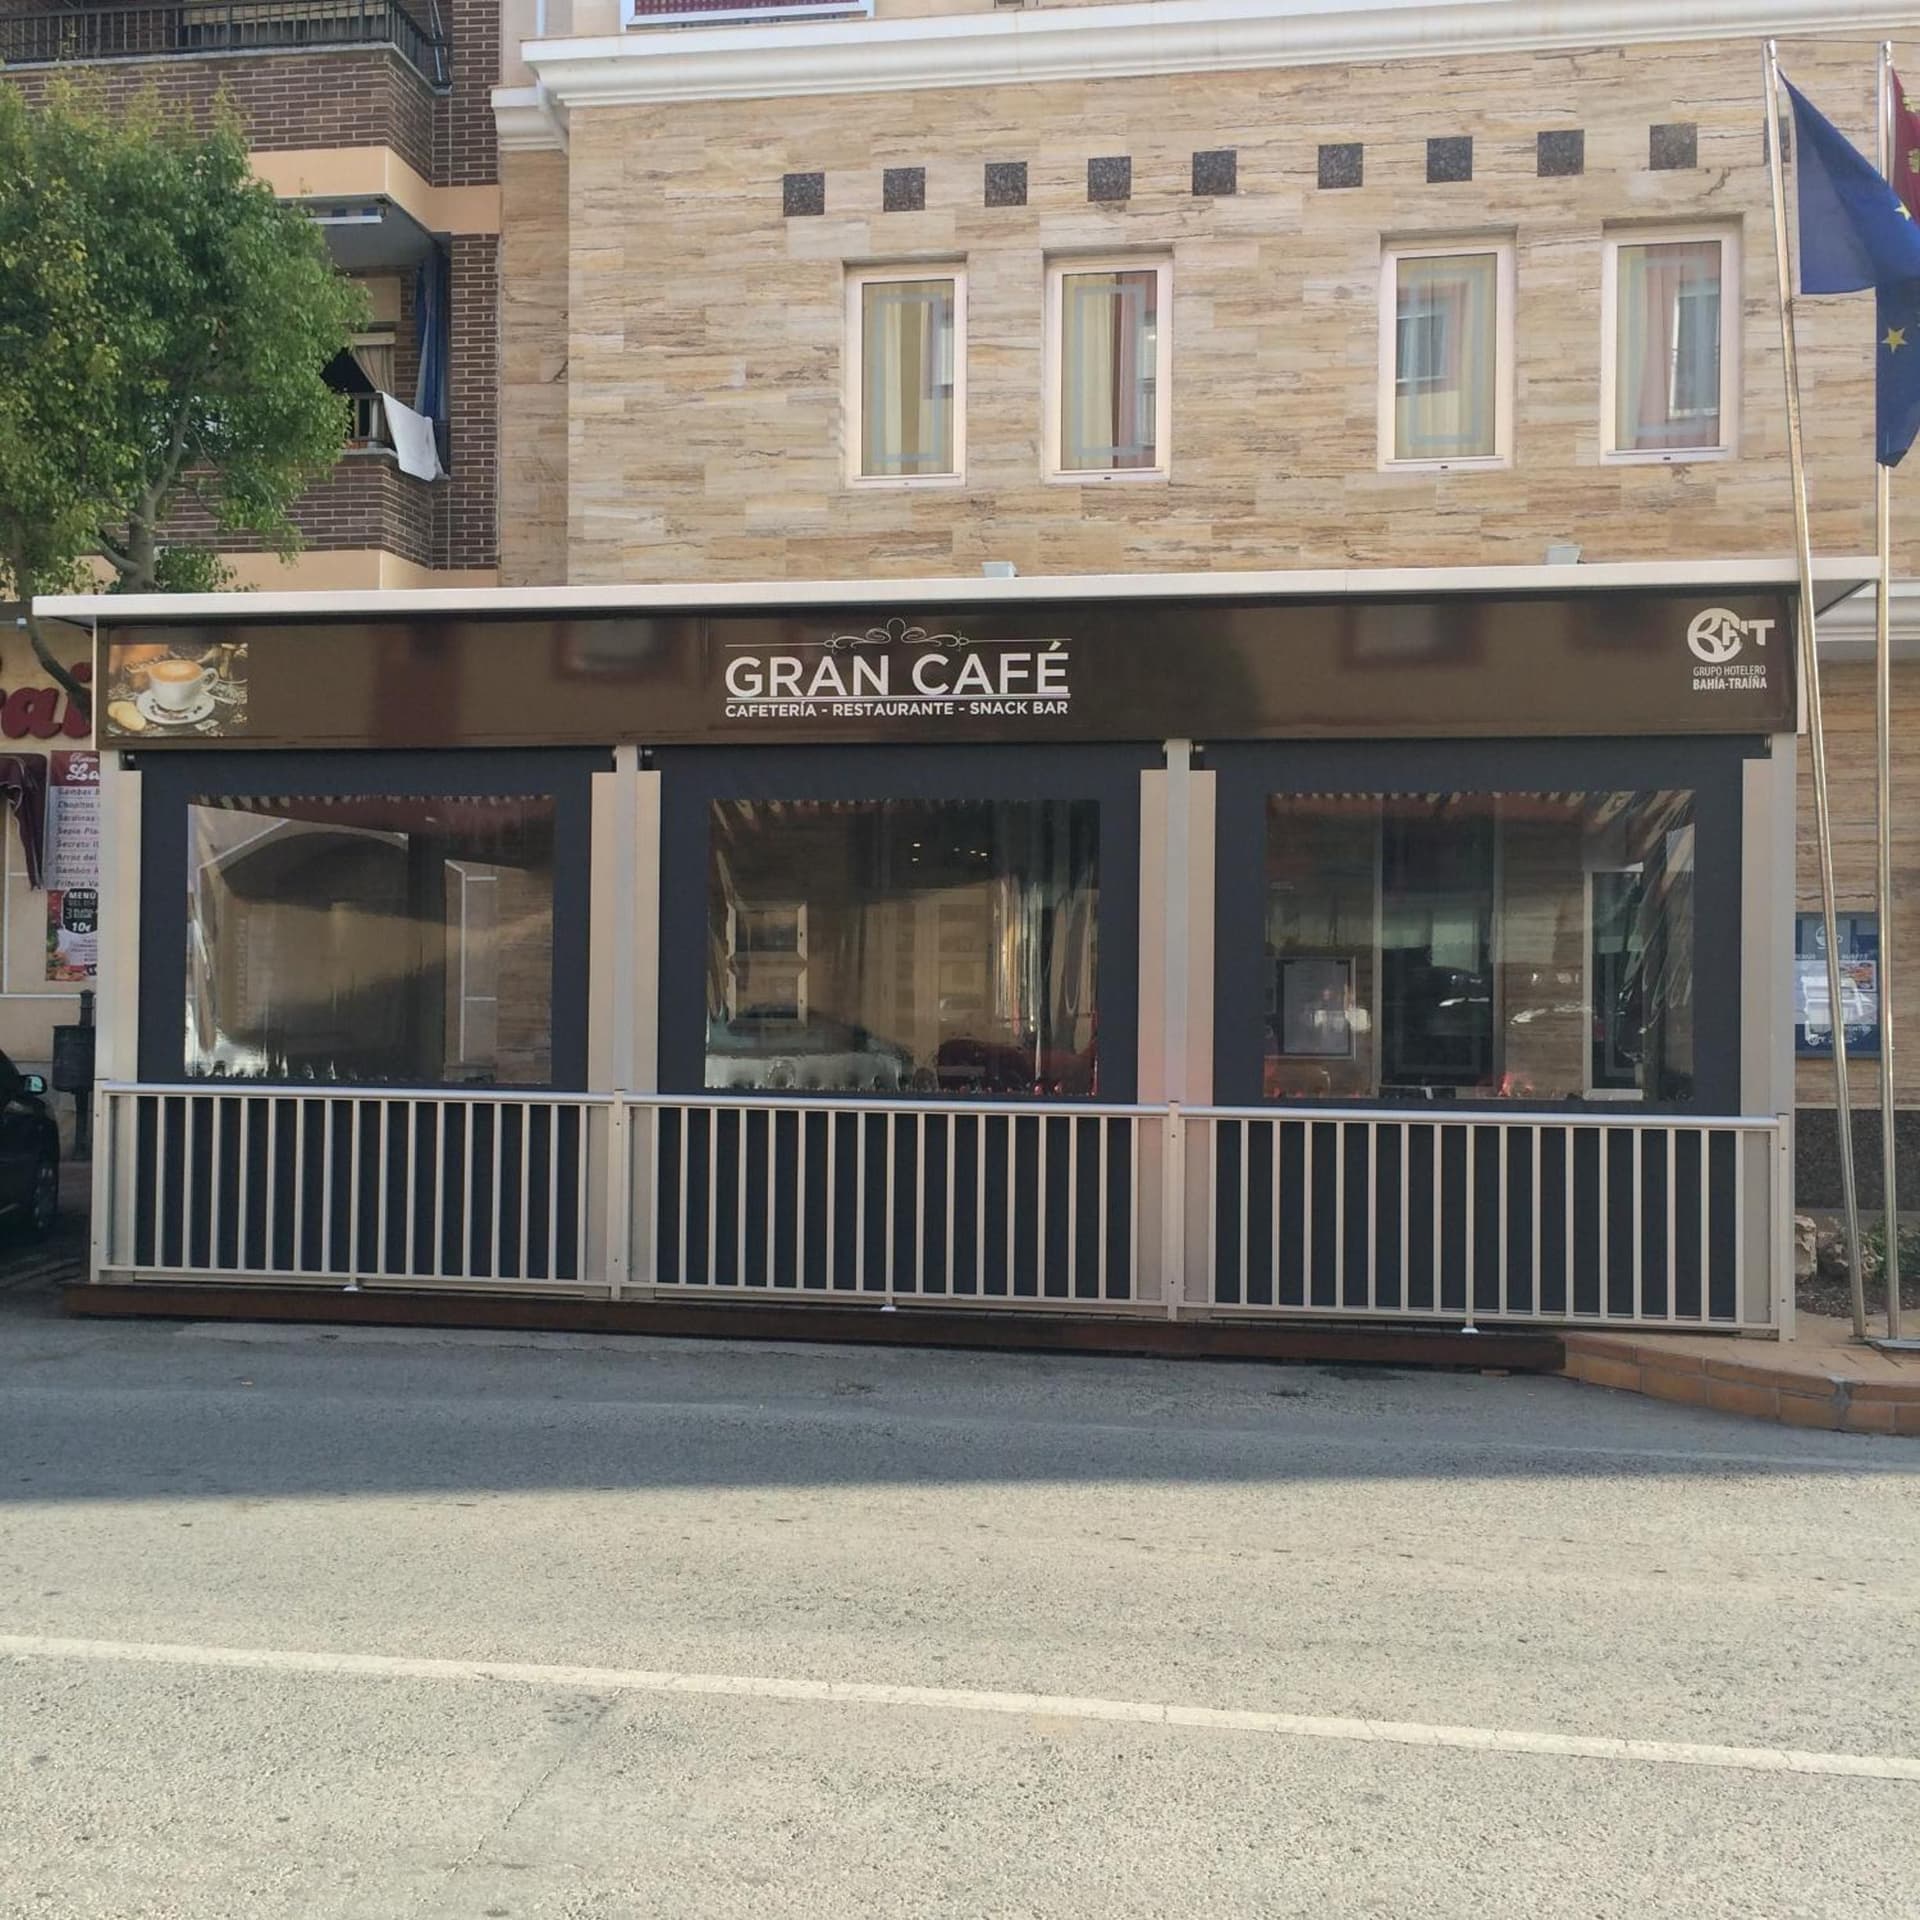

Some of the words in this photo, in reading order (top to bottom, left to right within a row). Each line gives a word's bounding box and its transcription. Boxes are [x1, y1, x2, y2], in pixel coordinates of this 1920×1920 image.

[724, 655, 889, 697] GRAN
[911, 640, 1070, 695] CAFÉ
[1692, 665, 1722, 677] GRUPO
[1724, 664, 1767, 676] HOTELERO
[724, 701, 817, 718] CAFETERÍA
[832, 702, 955, 717] RESTAURANTE
[969, 702, 1028, 715] SNACK
[1032, 701, 1068, 715] BAR
